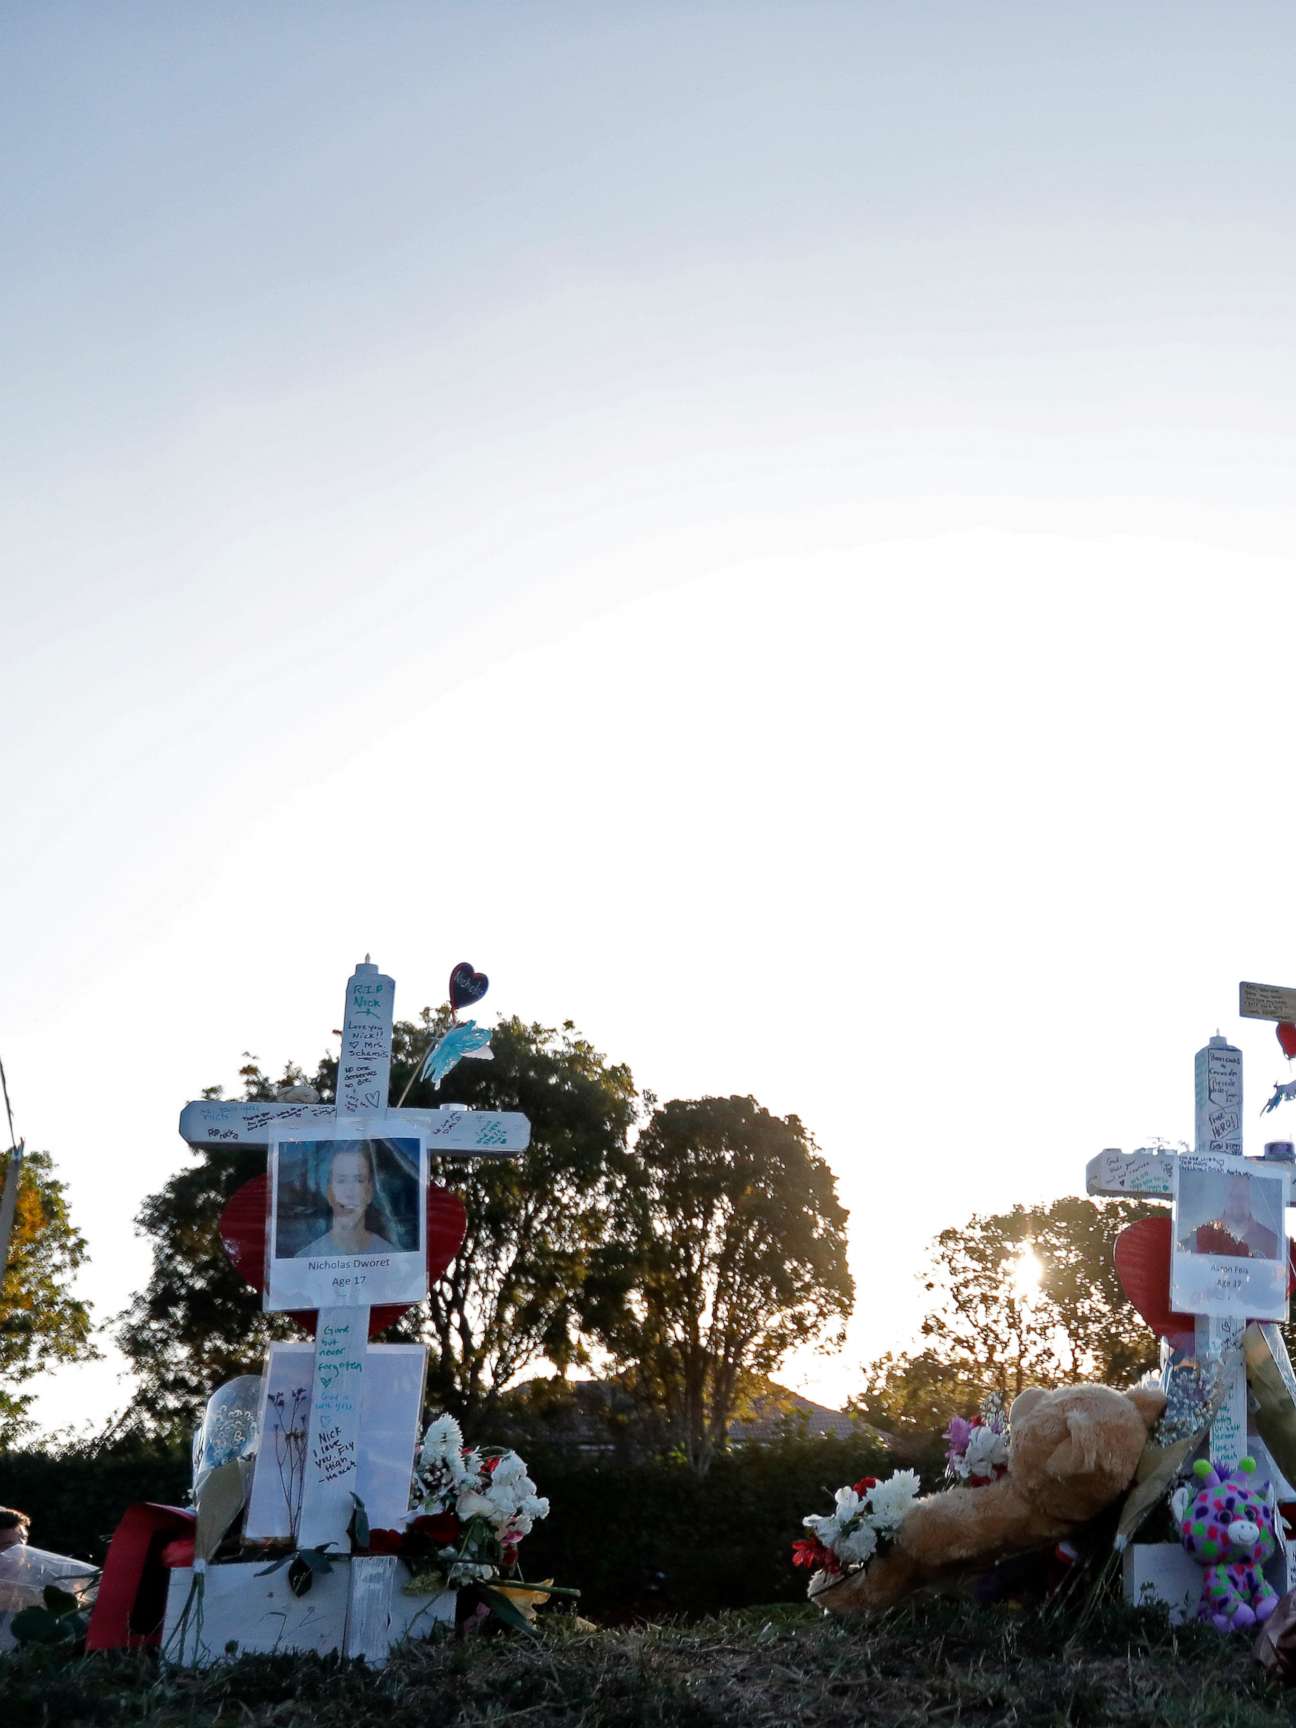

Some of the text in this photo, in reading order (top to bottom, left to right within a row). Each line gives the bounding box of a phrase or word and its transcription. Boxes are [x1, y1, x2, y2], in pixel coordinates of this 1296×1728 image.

[308, 1258, 390, 1271] Nicholas Dworet
[332, 1275, 367, 1288] Age 17
